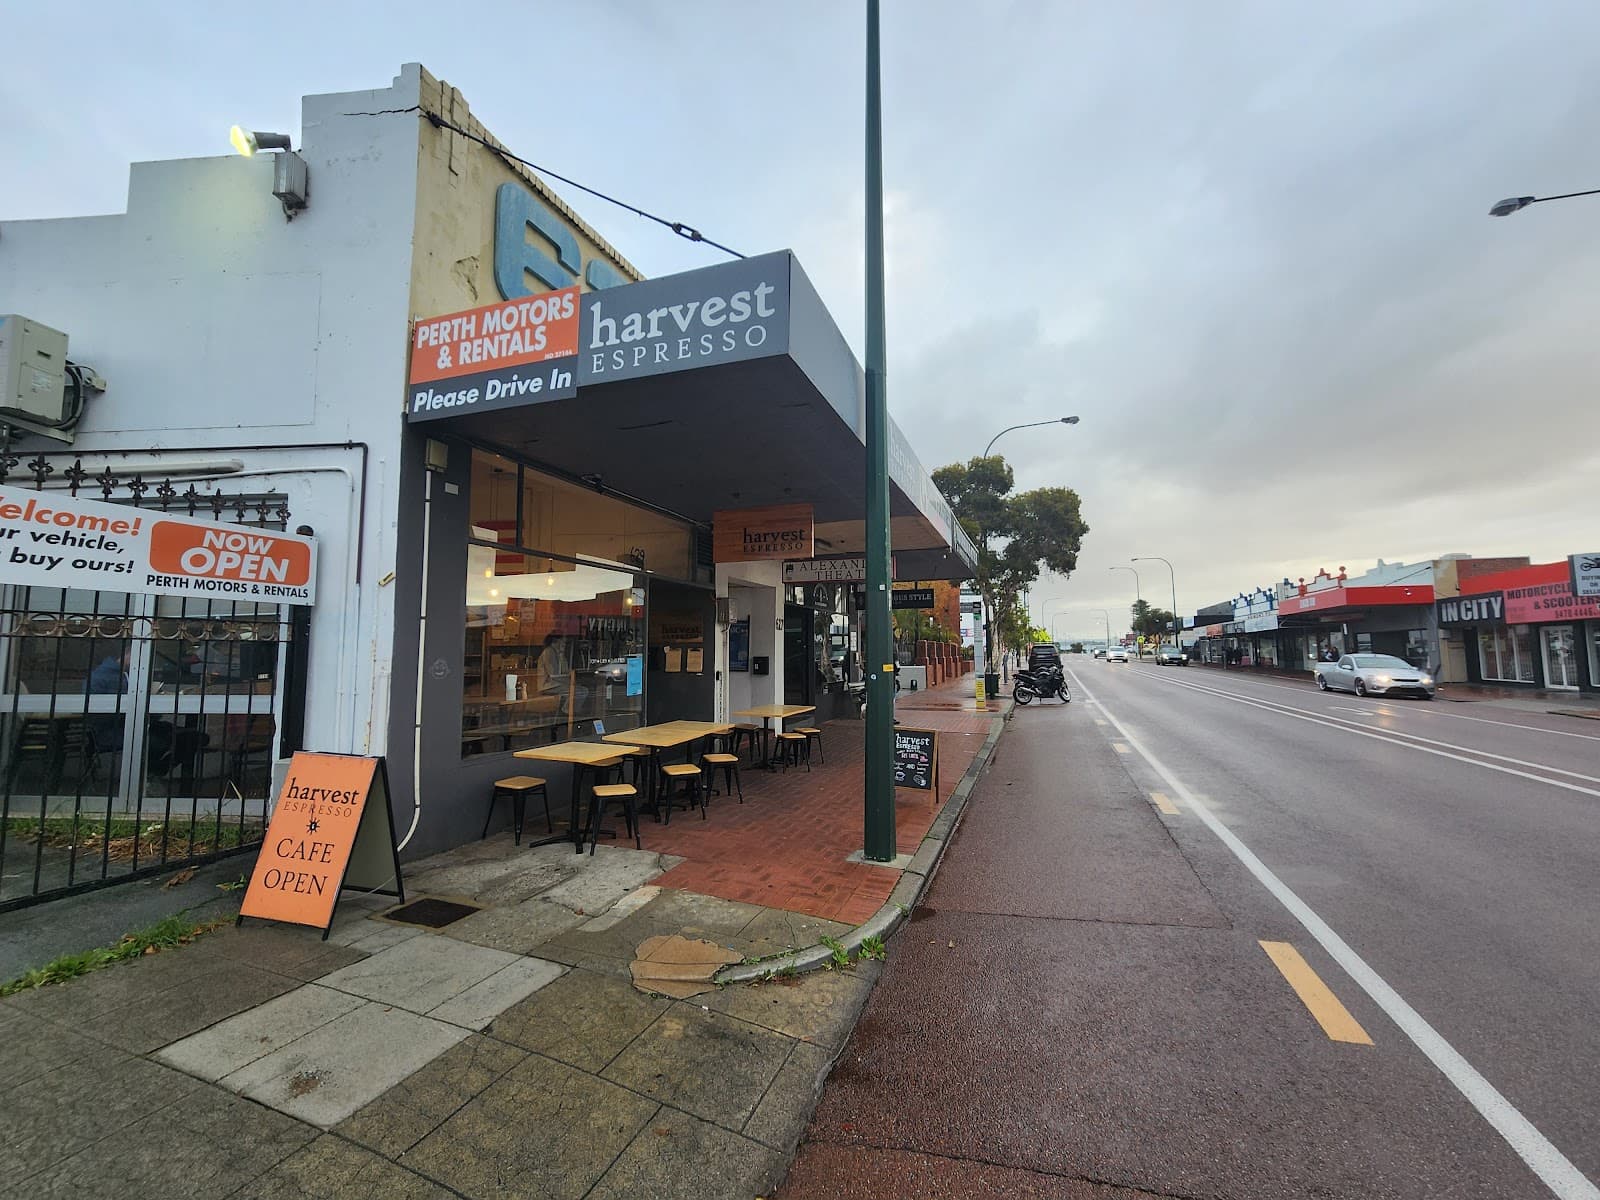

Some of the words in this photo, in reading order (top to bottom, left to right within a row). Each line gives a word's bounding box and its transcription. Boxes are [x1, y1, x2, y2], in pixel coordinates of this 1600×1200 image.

[417, 315, 475, 349] PERTH
[481, 293, 574, 336] MOTORS
[589, 282, 776, 349] harvest
[437, 346, 452, 369] &
[459, 326, 547, 365] RENTALS
[591, 325, 767, 374] ESPRESSO
[413, 388, 479, 413] Please
[485, 374, 543, 400] Drive
[550, 368, 572, 390] In
[0, 497, 142, 536] elcome!
[30, 530, 125, 554] vehicle,
[202, 530, 274, 555] NOW
[743, 527, 805, 544] harvest
[743, 542, 803, 553] ESPRESSO
[8, 546, 64, 571] buy
[71, 559, 134, 574] ours!
[180, 546, 289, 582] OPEN
[146, 574, 189, 589] PERTH
[193, 579, 247, 593] MOTORS
[251, 584, 260, 595] &
[264, 585, 309, 598] RENTALS
[814, 569, 865, 580] THEAT
[1441, 602, 1458, 622] IN
[1460, 596, 1504, 621] CITY
[895, 732, 930, 746] harvest
[286, 777, 360, 805] harvest
[283, 801, 352, 817] ESPRESSO
[276, 838, 335, 864] CAFE
[264, 868, 329, 896] OPEN
